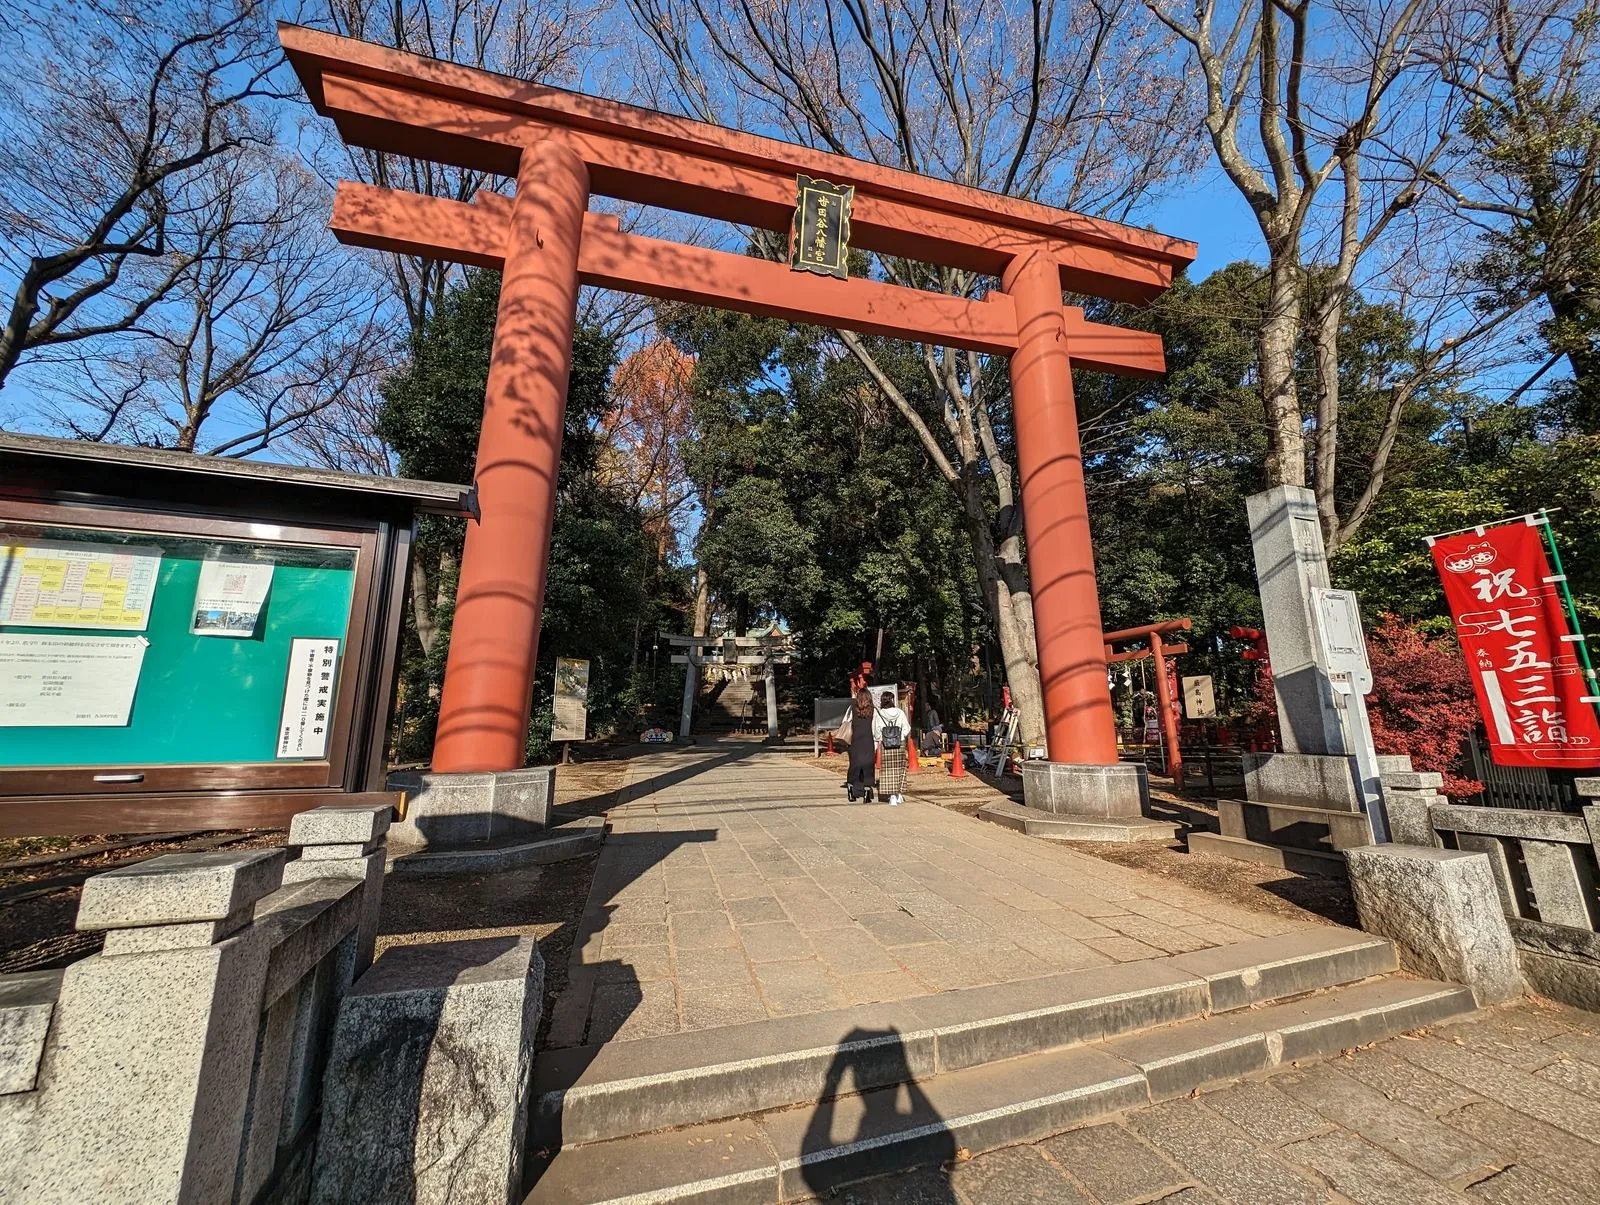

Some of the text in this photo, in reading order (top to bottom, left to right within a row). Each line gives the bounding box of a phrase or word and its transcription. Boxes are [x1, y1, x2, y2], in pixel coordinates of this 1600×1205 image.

[1476, 648, 1494, 669] 奉納
[313, 645, 334, 735] 特別警戒実施中
